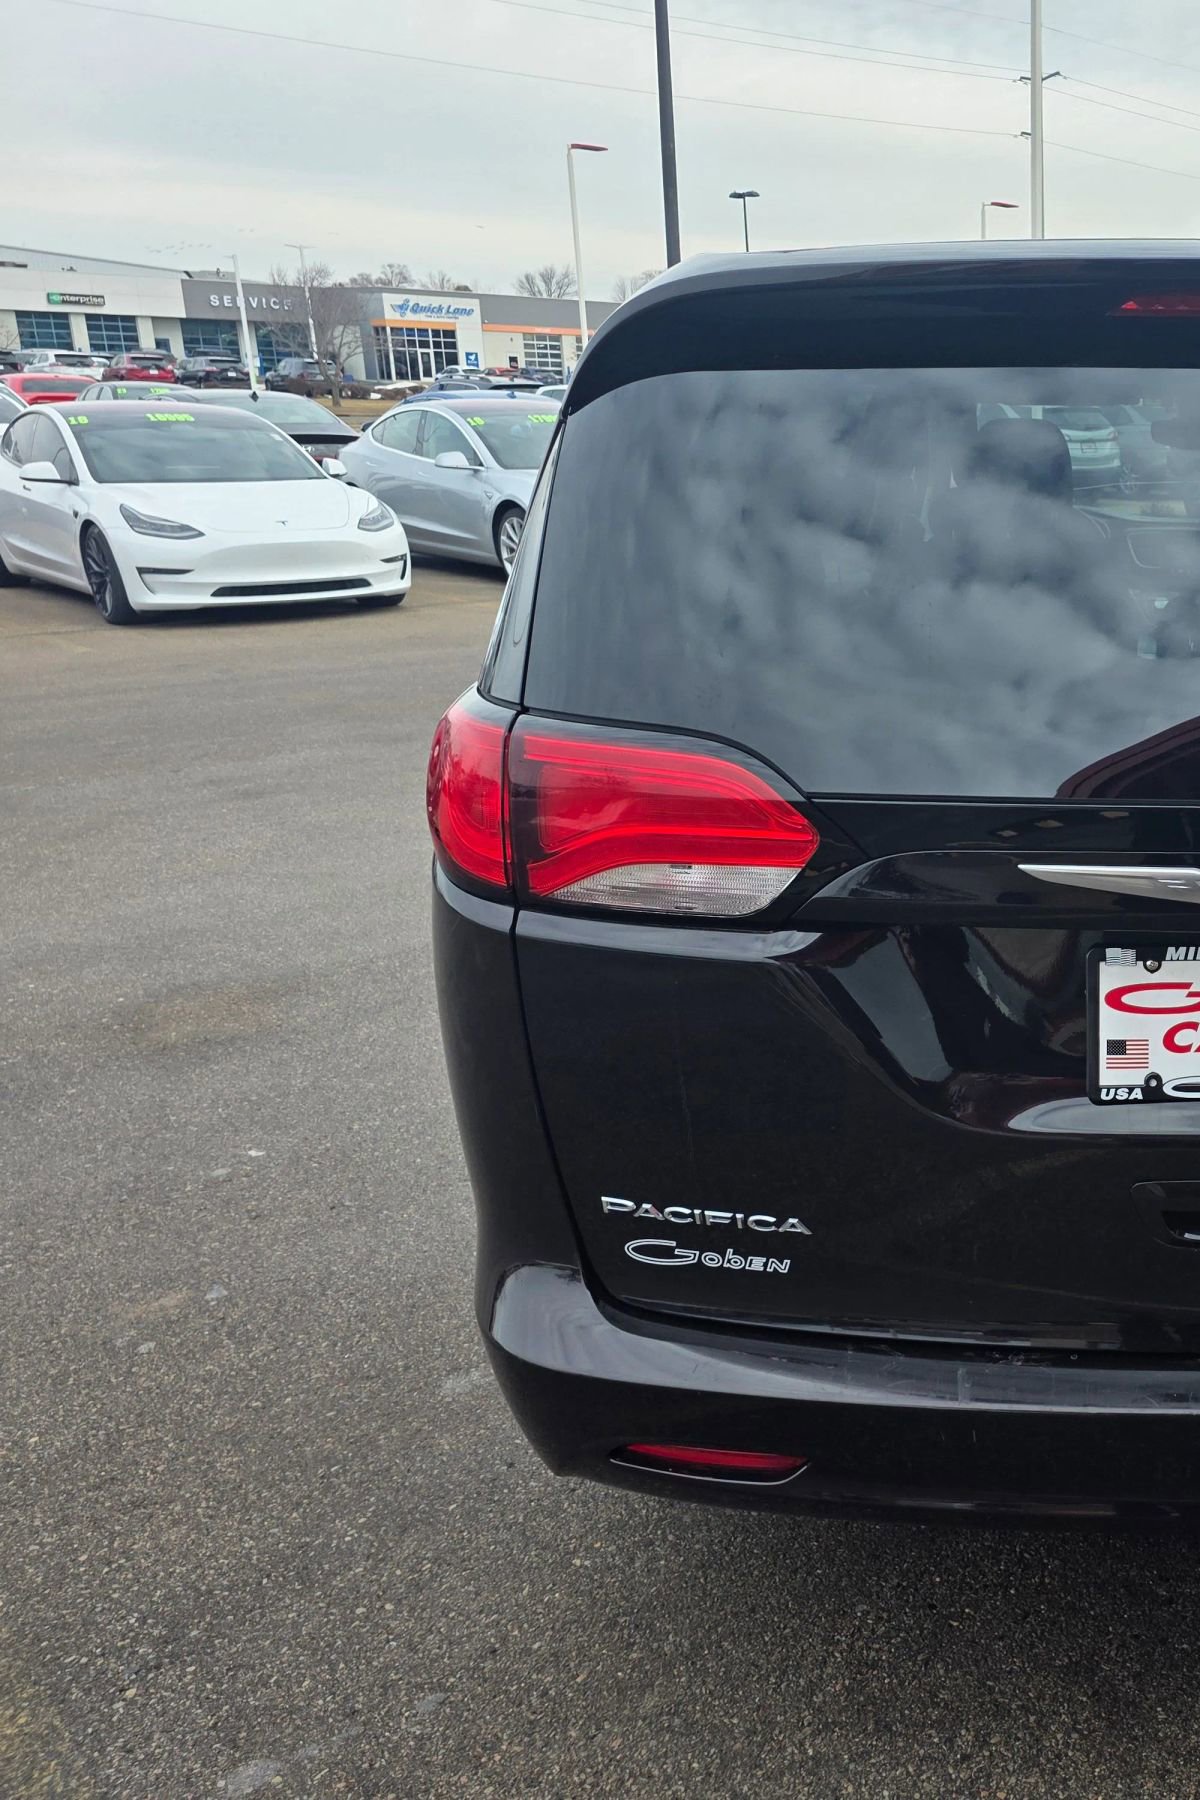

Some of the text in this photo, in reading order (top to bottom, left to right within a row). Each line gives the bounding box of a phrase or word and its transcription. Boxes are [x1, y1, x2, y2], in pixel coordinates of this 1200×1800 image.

[410, 303, 474, 316] Quick Lane
[1100, 1087, 1144, 1101] USA
[601, 1196, 813, 1235] PACIFICA
